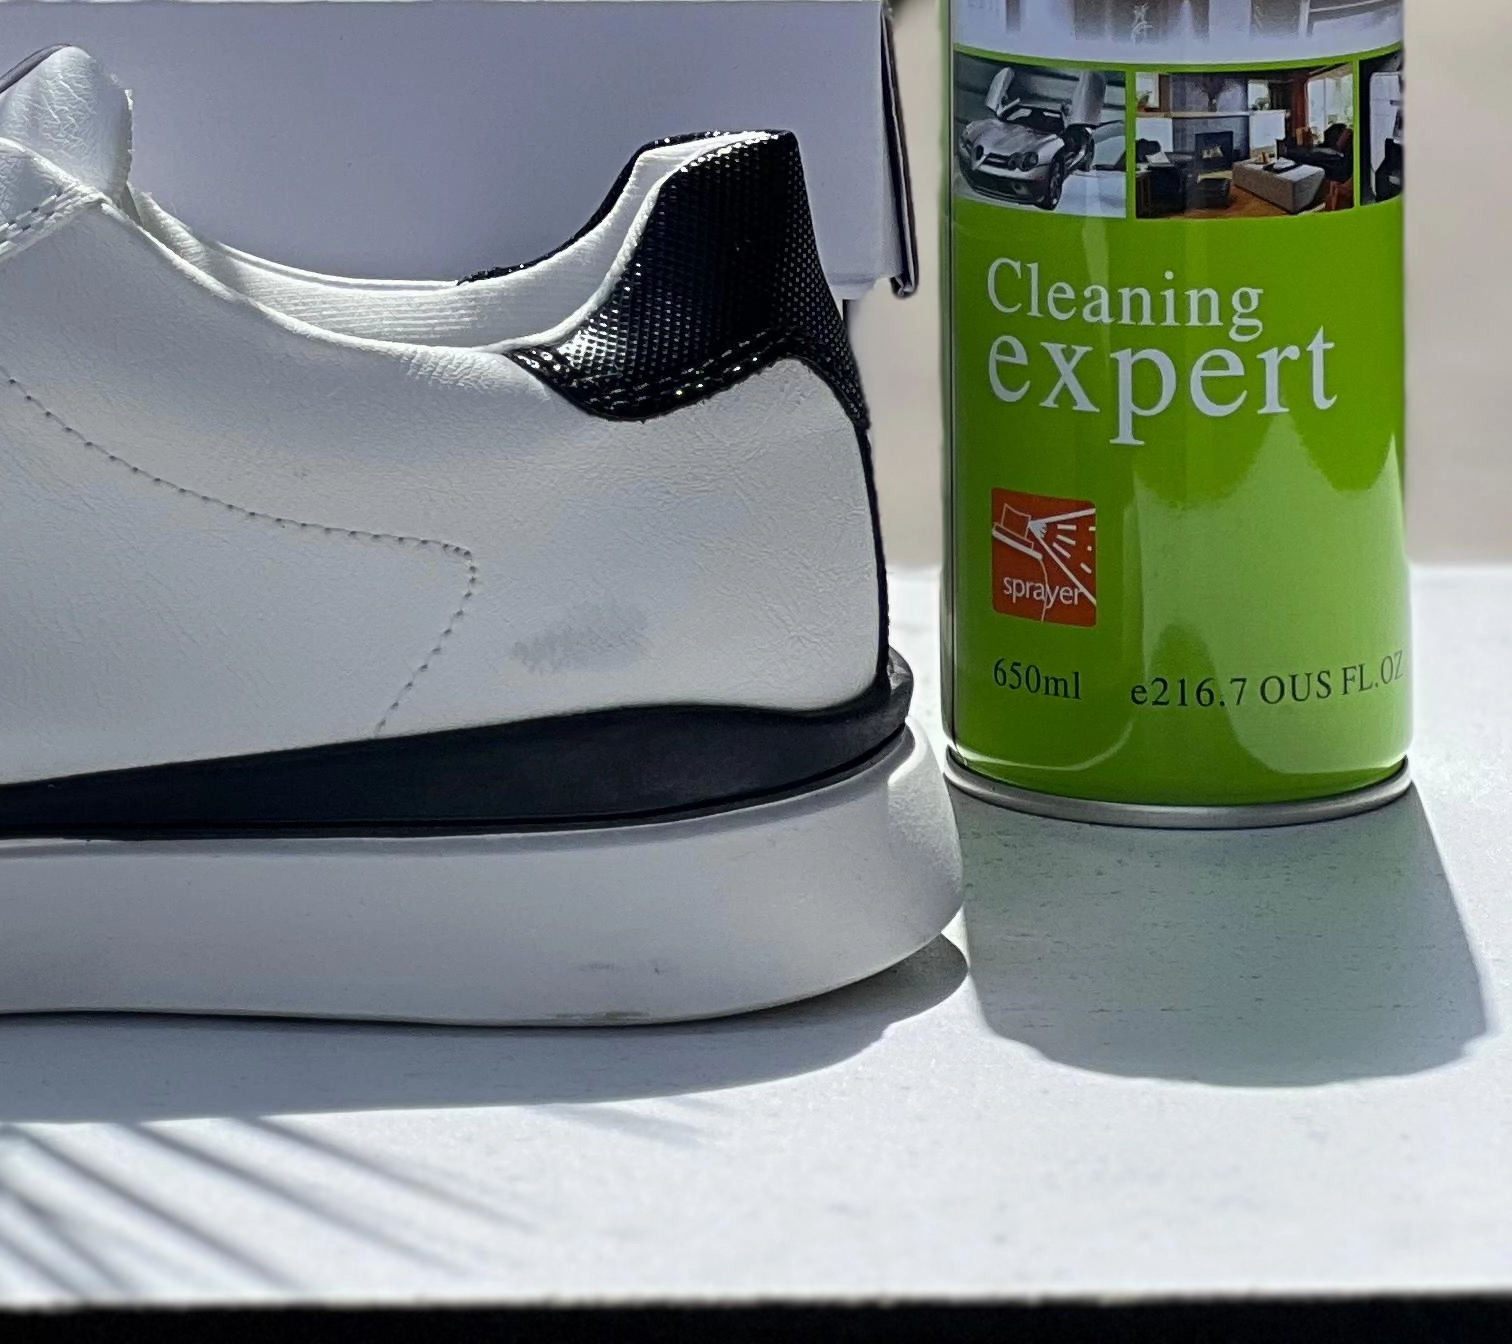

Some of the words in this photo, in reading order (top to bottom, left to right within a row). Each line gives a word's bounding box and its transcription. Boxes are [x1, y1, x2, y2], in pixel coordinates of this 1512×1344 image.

[987, 257, 1264, 342] Cleaning
[988, 325, 1338, 445] expert
[1003, 576, 1082, 610] sprayer
[993, 657, 1081, 700] 650ml
[1130, 677, 1247, 707] e216.7
